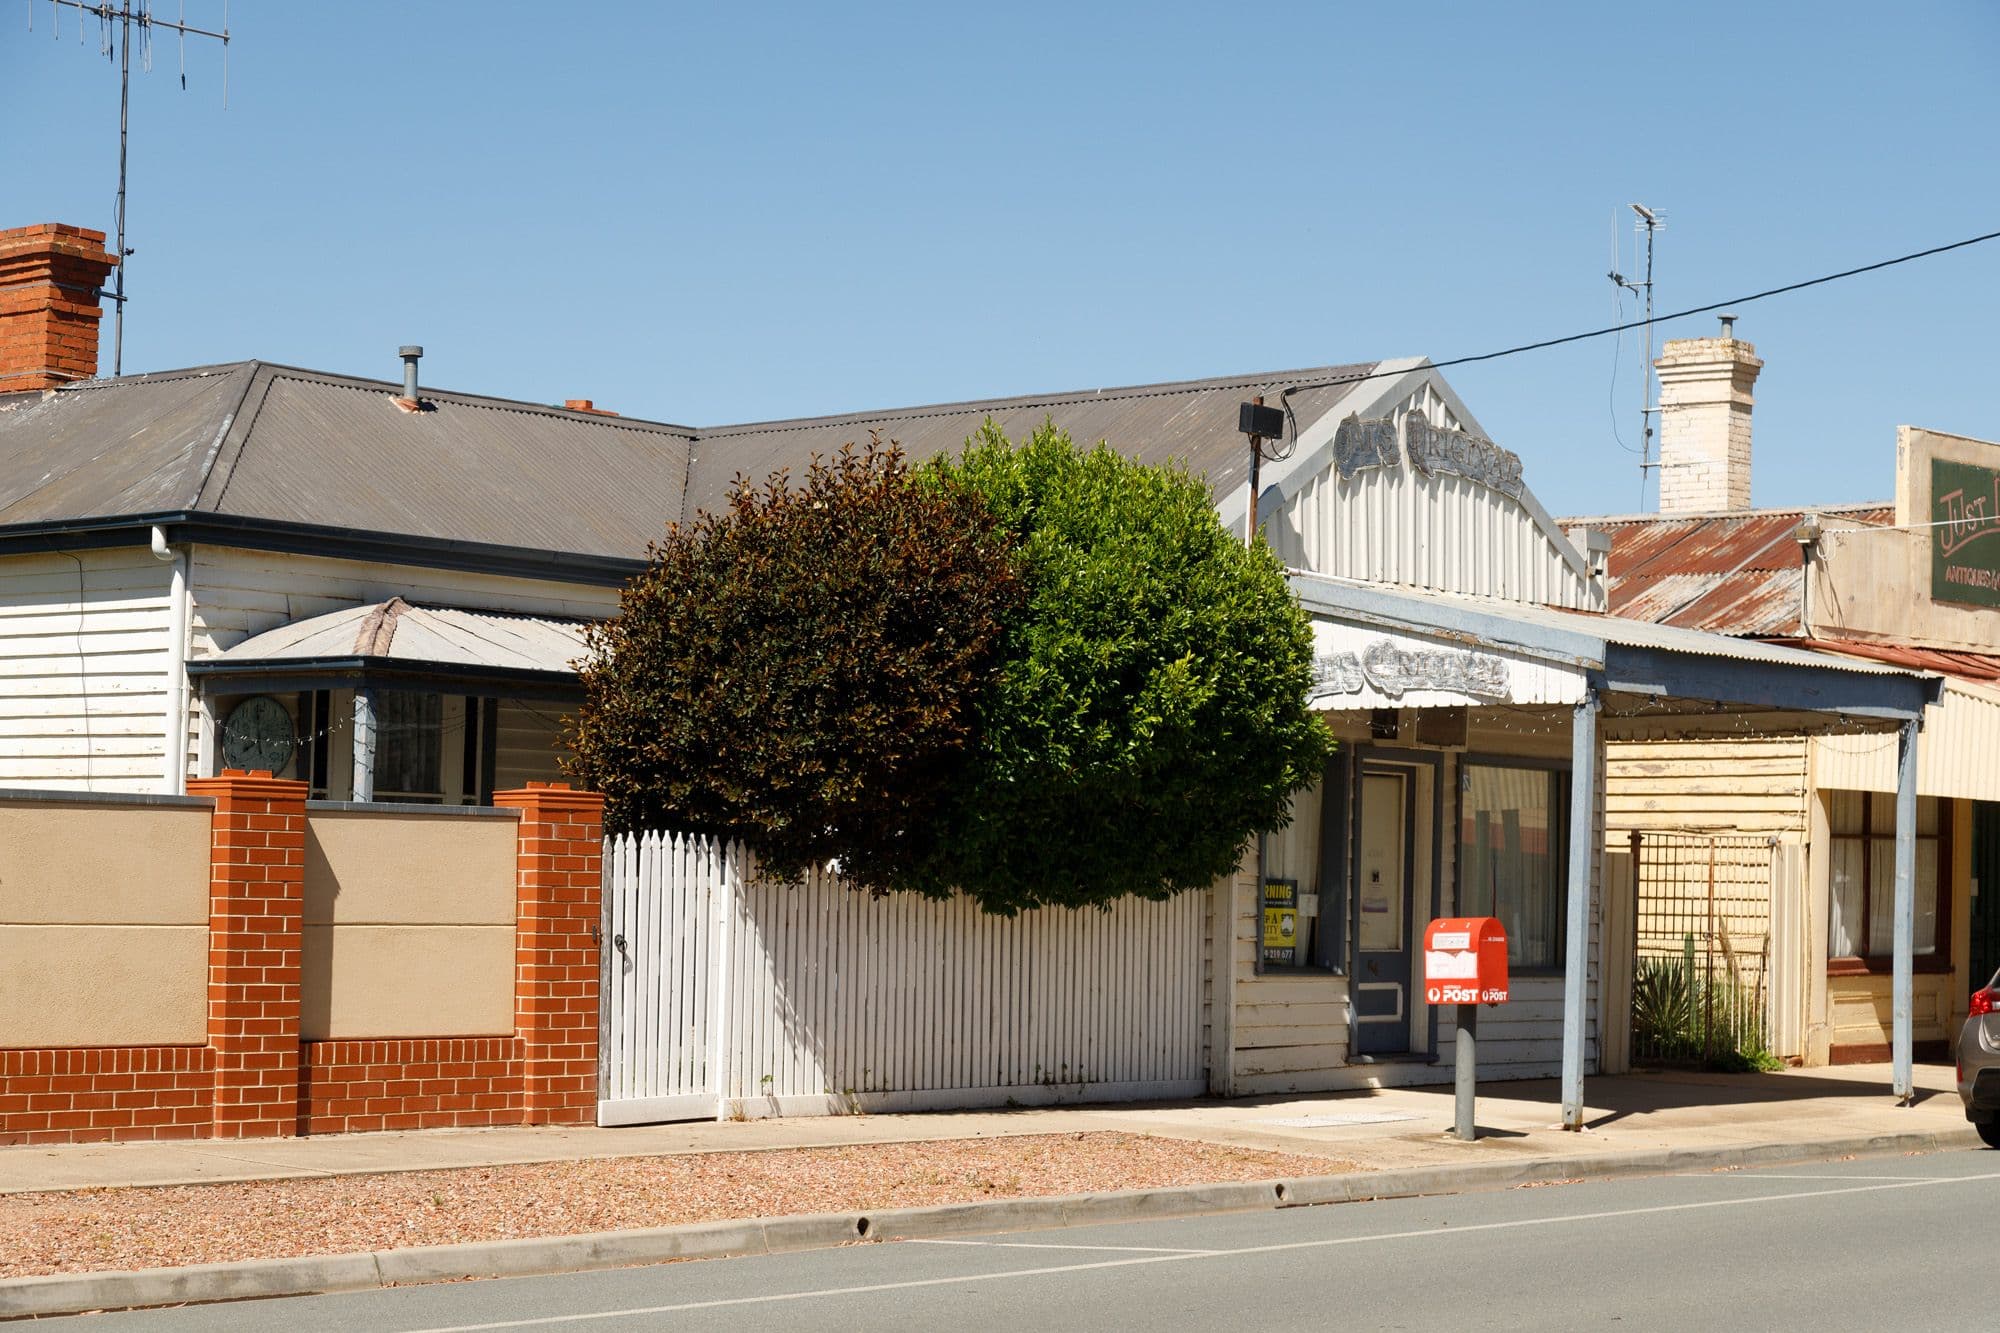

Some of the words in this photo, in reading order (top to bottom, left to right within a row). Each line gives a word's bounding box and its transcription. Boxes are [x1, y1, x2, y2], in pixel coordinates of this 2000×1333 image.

[1940, 488, 1986, 550] JUST
[1945, 565, 1991, 589] ANTIQUES
[1264, 884, 1292, 899] RNING
[1443, 989, 1478, 1001] POST
[1489, 992, 1507, 1001] POST
